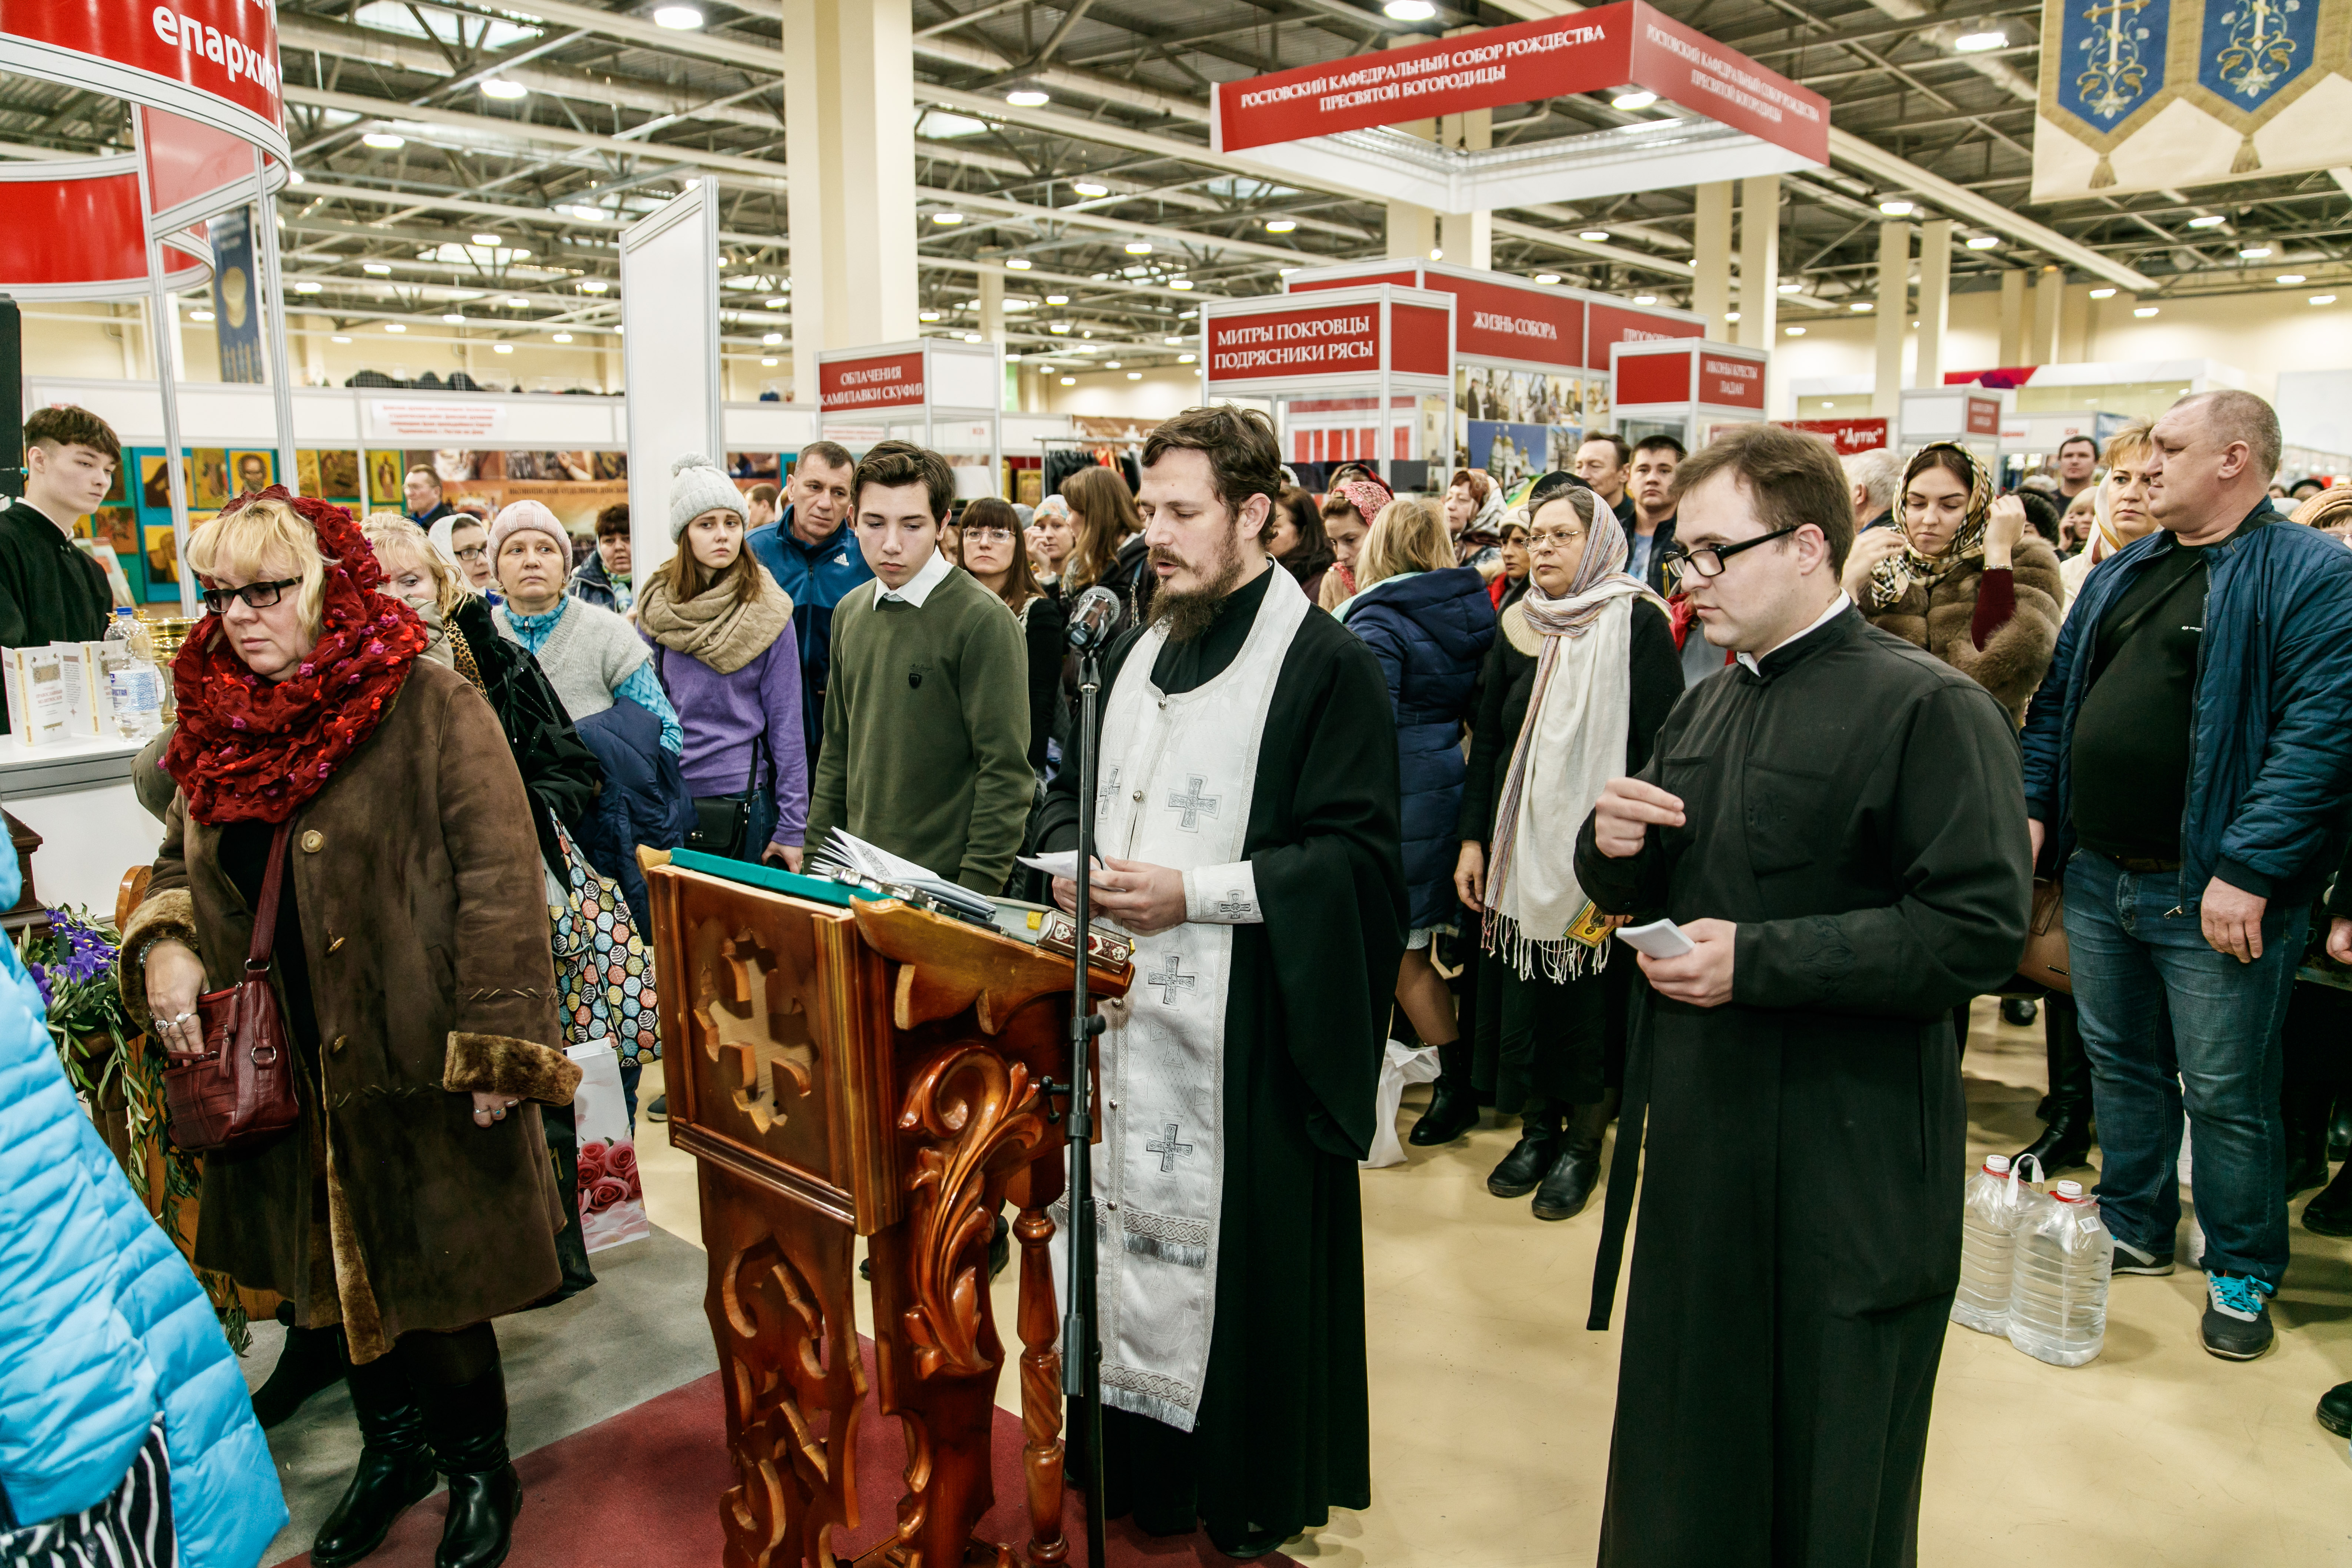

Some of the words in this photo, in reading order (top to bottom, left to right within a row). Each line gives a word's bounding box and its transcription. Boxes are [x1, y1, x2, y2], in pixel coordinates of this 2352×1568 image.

[153, 6, 278, 99] епархия
[1241, 77, 1327, 108] РОСТОВСКИЙ
[1329, 53, 1450, 91] КАФЕДРАЛЬНЫЙ
[1452, 44, 1504, 67] СОБОР
[1506, 24, 1605, 57] РОЖДЕСТВА
[1320, 83, 1400, 111] ПРЕСВЯТОЙ
[1402, 65, 1506, 97] БОГОРОДИЦЫ
[1217, 326, 1273, 346] МИТРЫ
[1277, 316, 1370, 340] ПОКРОВЦЫ
[1473, 311, 1515, 333] ЖИЗНЬ
[1515, 318, 1557, 340] СОБОРА
[1215, 344, 1324, 370] ПОДРЯСНИКИ
[1328, 340, 1374, 360] РЯСЫ
[1706, 360, 1732, 375] ИКОНЫ
[1733, 364, 1758, 380] КРЕСТЫ
[840, 366, 902, 386] ОБЛАЧЕНИЯ
[820, 387, 881, 406] КАМИЛАВКИ
[882, 382, 924, 400] СКУФИ
